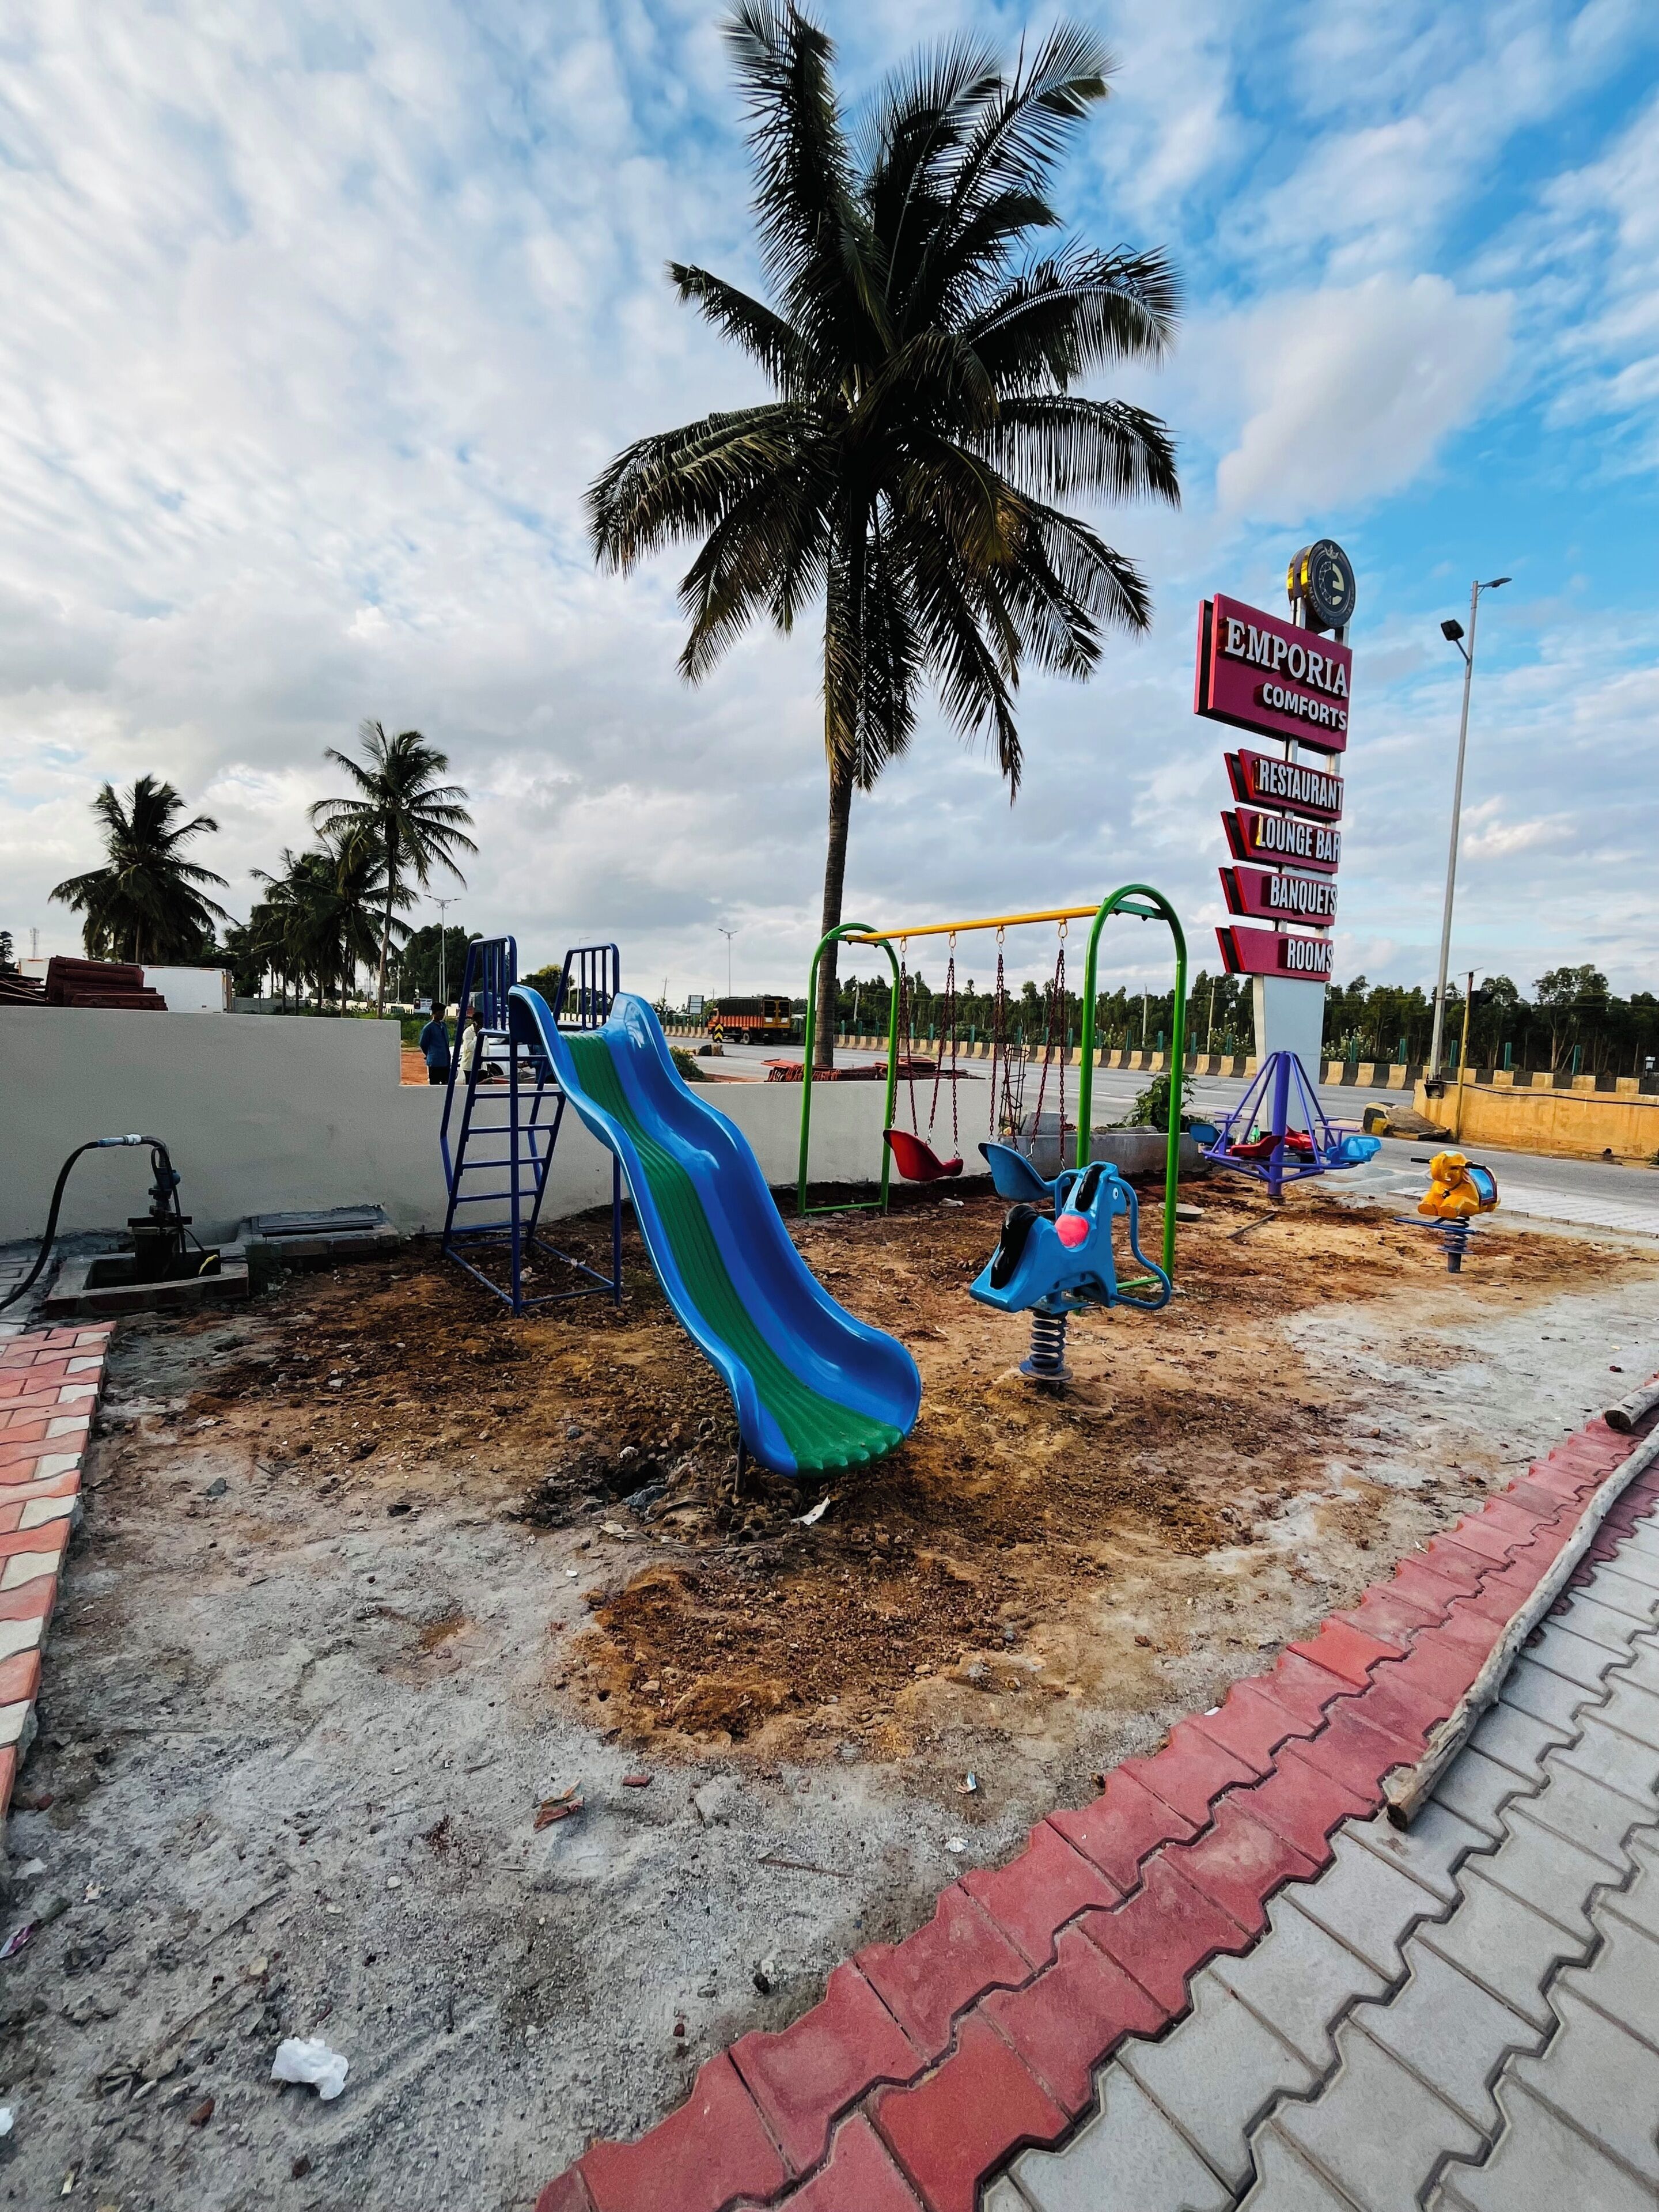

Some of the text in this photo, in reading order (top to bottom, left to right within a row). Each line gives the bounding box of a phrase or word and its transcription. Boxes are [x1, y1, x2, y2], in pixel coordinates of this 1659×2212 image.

[1225, 617, 1348, 698] EMPORIA
[1263, 683, 1347, 730] COMFORTS
[1259, 759, 1343, 810] RESTAURANT
[1258, 815, 1341, 862] LOUNGE BAR
[1270, 876, 1337, 916] BANQUETS
[1287, 938, 1333, 974] ROOMS
